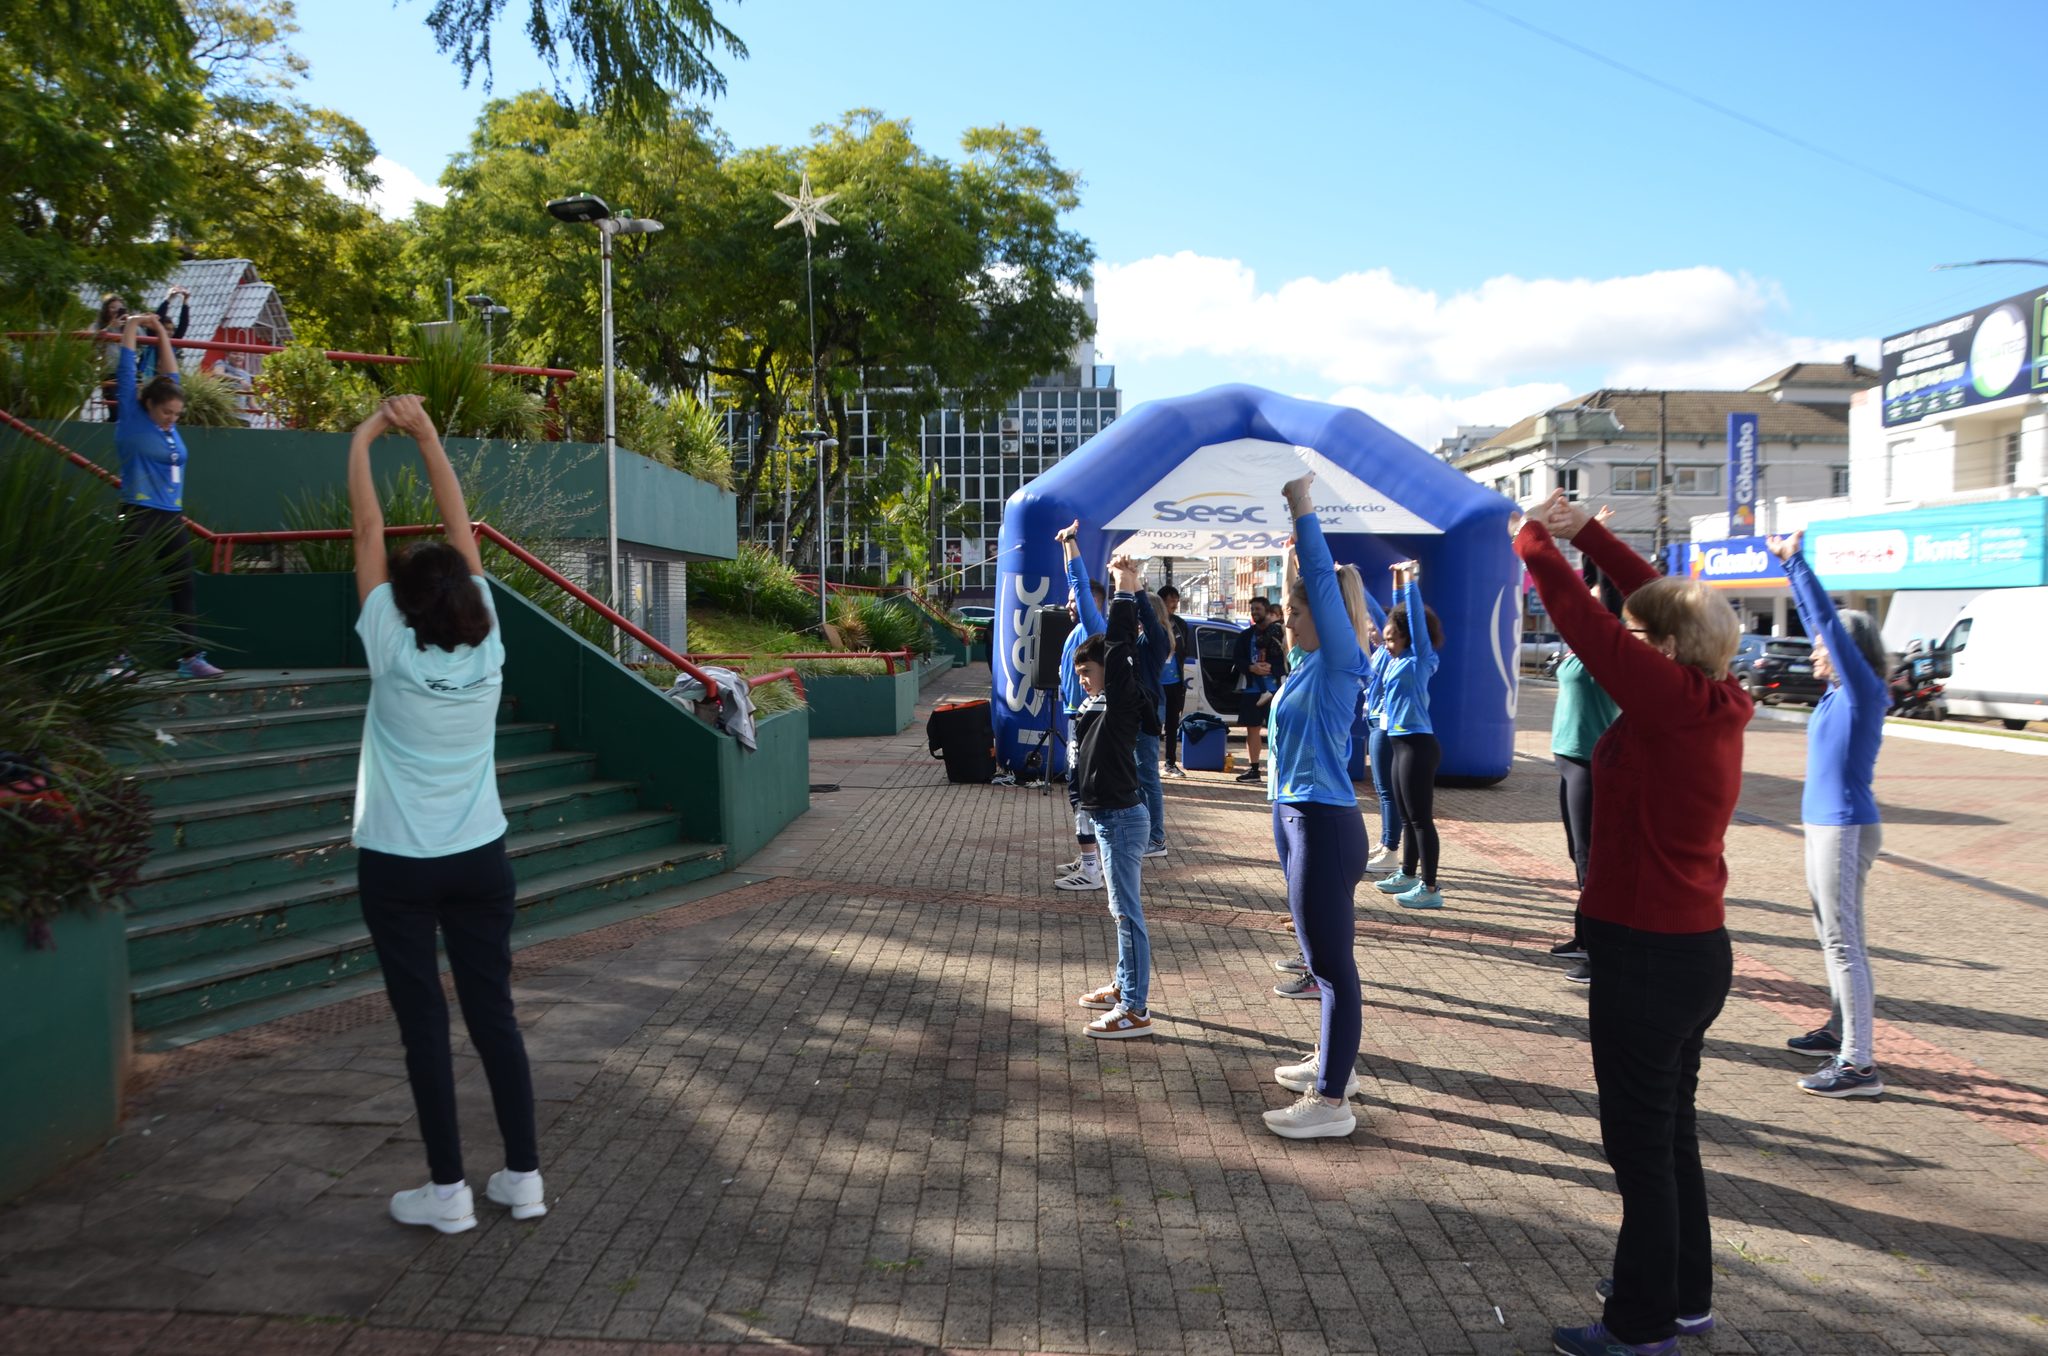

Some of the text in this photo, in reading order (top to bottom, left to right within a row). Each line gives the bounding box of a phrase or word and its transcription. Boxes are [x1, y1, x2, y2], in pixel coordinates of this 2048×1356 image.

[1026, 418, 1057, 429] JUSTIÇA
[1062, 417, 1094, 427] FEDERAL
[1064, 436, 1075, 444] 301
[1736, 421, 1754, 505] Colombo
[1153, 500, 1268, 523] Sesc
[1283, 503, 1386, 512] Fomércio
[1287, 517, 1343, 525] Sac
